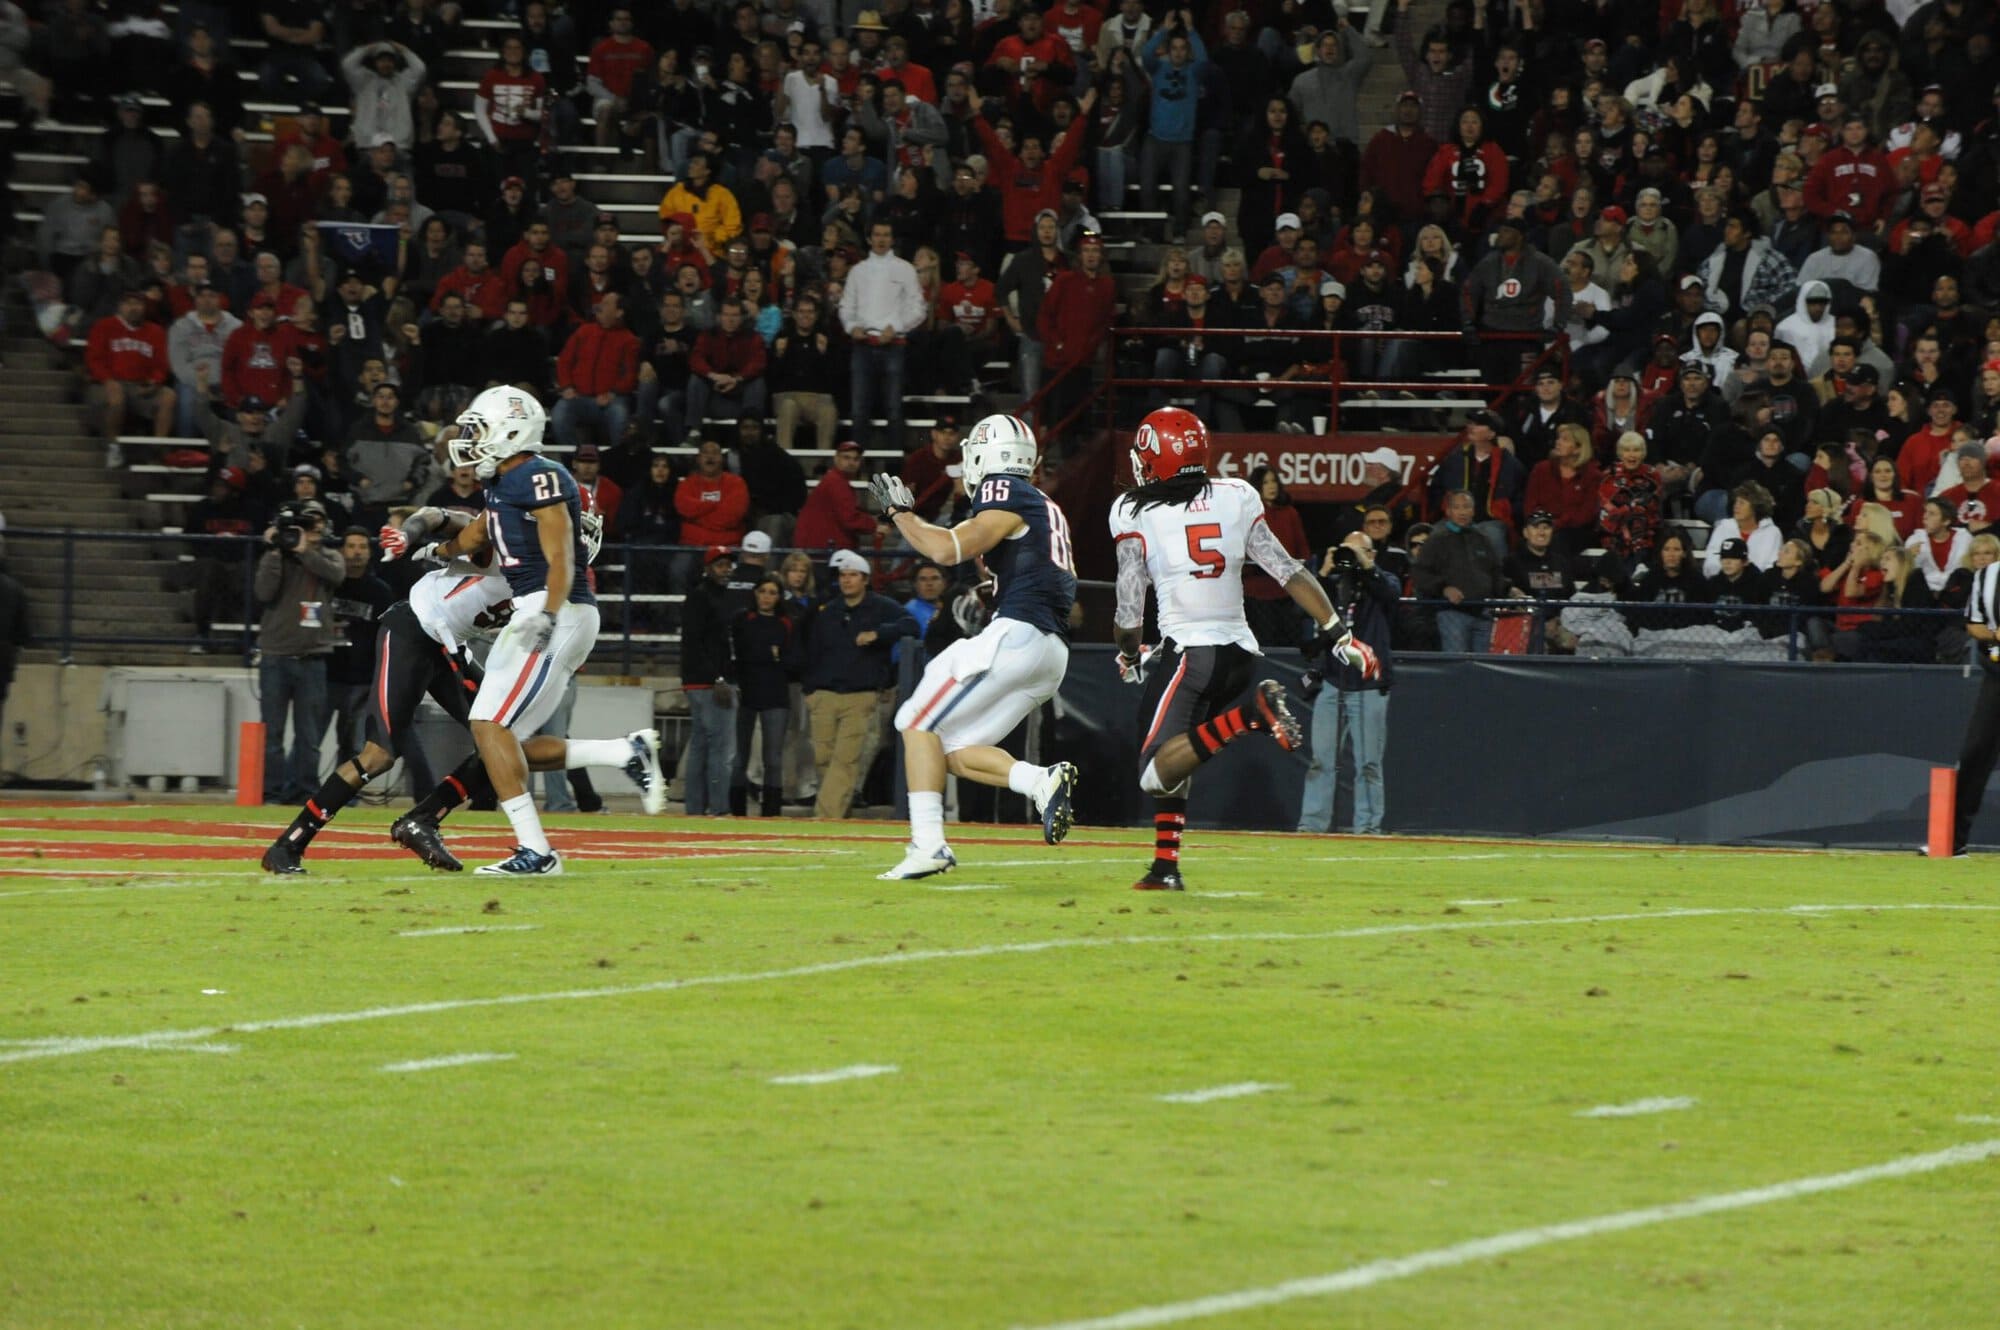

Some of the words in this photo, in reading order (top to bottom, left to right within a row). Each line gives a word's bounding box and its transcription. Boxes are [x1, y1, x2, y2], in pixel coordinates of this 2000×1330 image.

[1278, 453, 1366, 486] SECTIO
[532, 471, 563, 500] 21
[981, 479, 1010, 503] 85
[1184, 522, 1226, 579] 5
